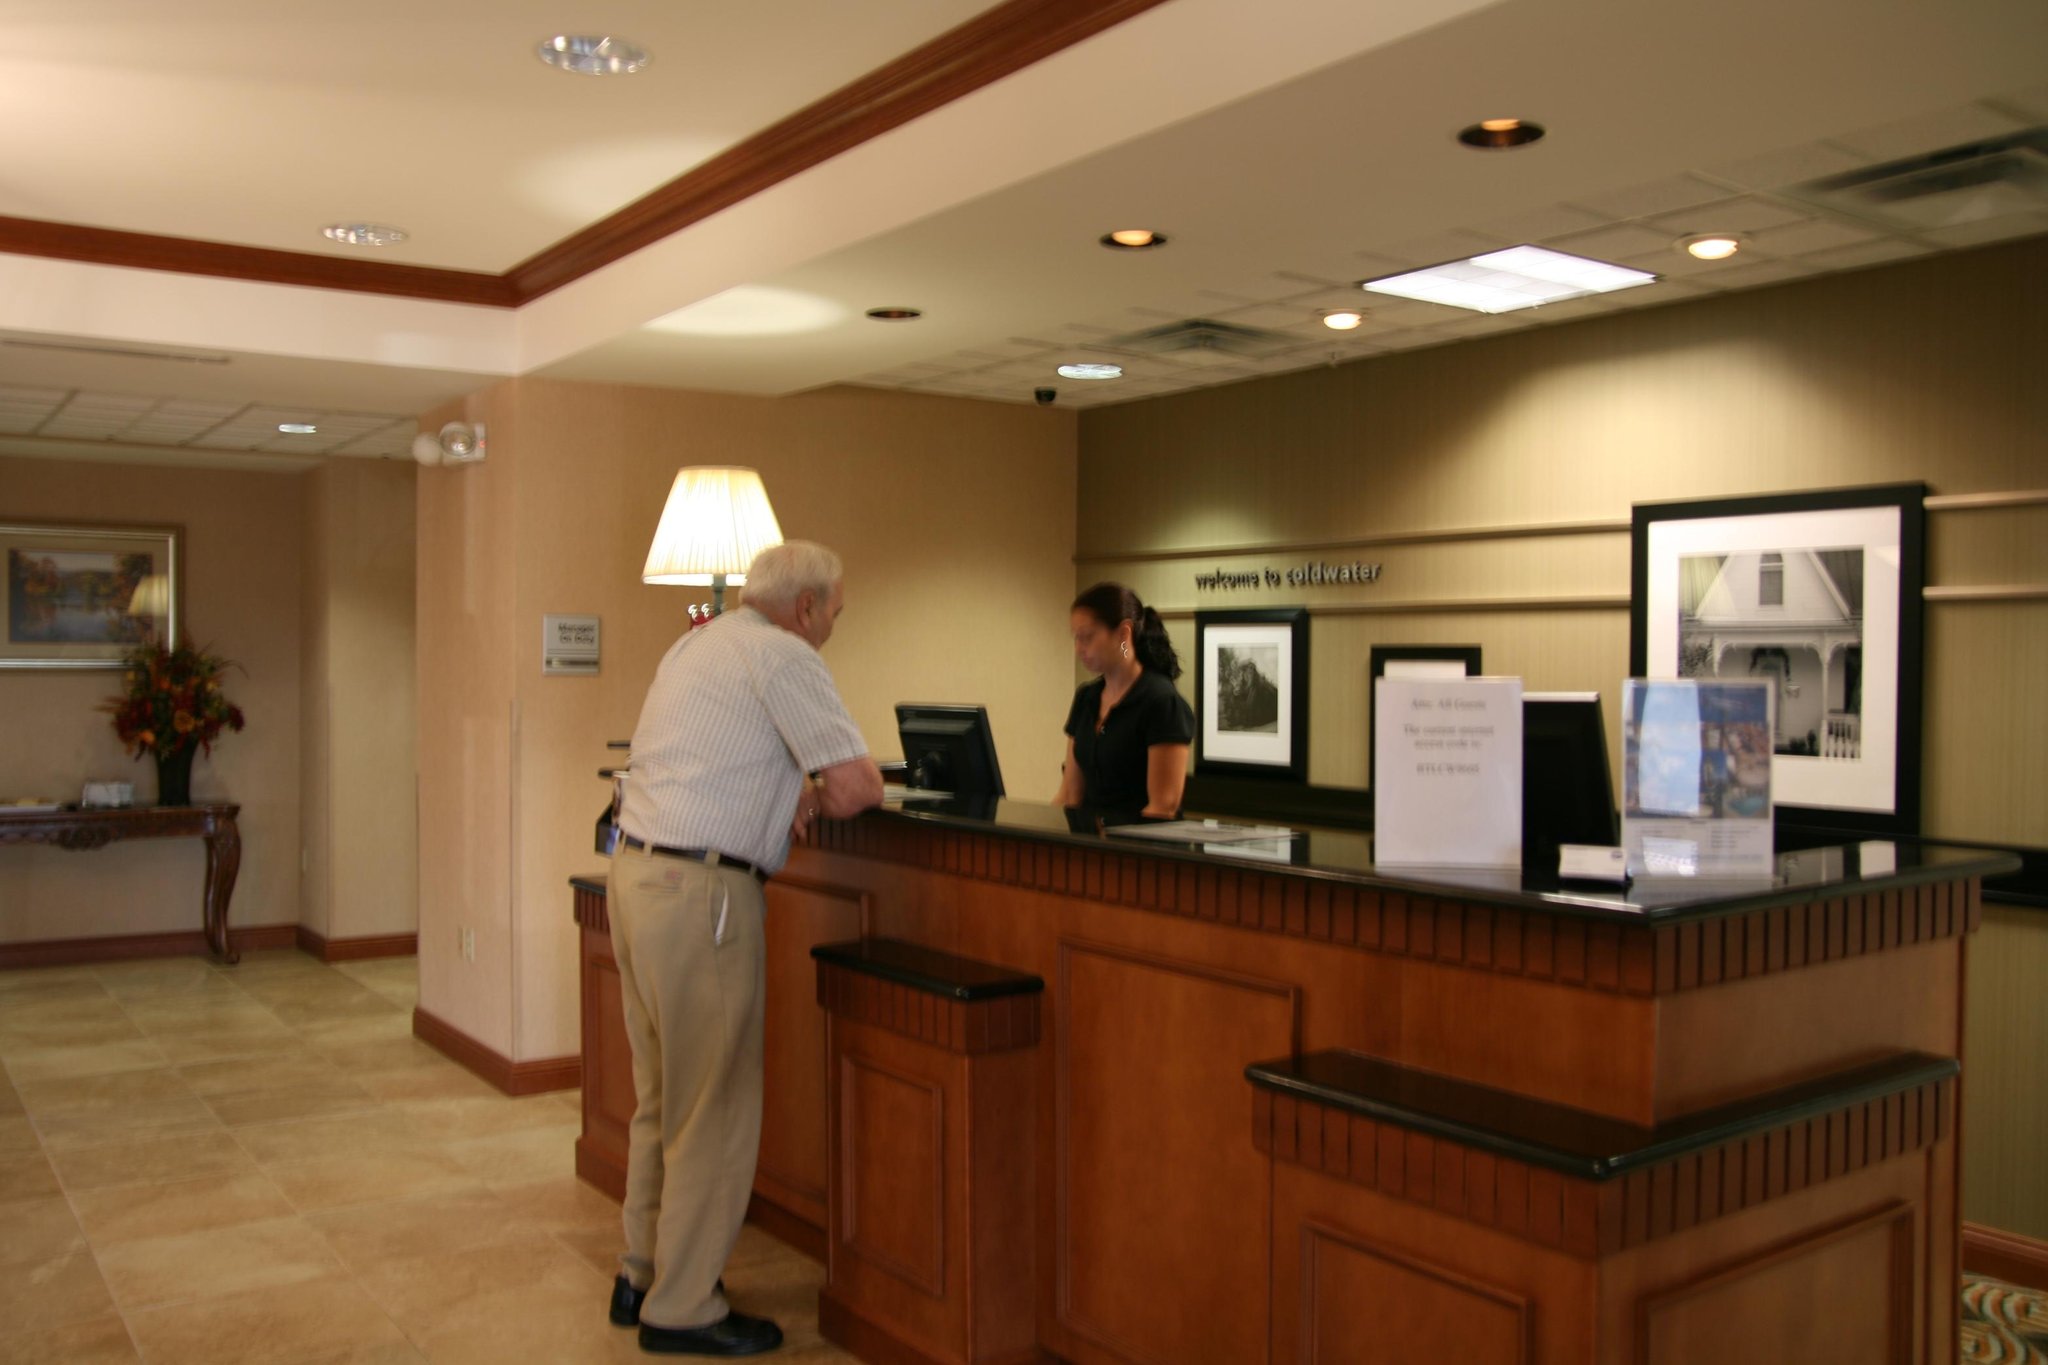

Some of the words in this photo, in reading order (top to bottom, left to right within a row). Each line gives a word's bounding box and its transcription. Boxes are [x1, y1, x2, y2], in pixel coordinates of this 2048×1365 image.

[1195, 567, 1260, 590] welcome
[1264, 566, 1281, 588] to
[1285, 562, 1381, 587] coldwater
